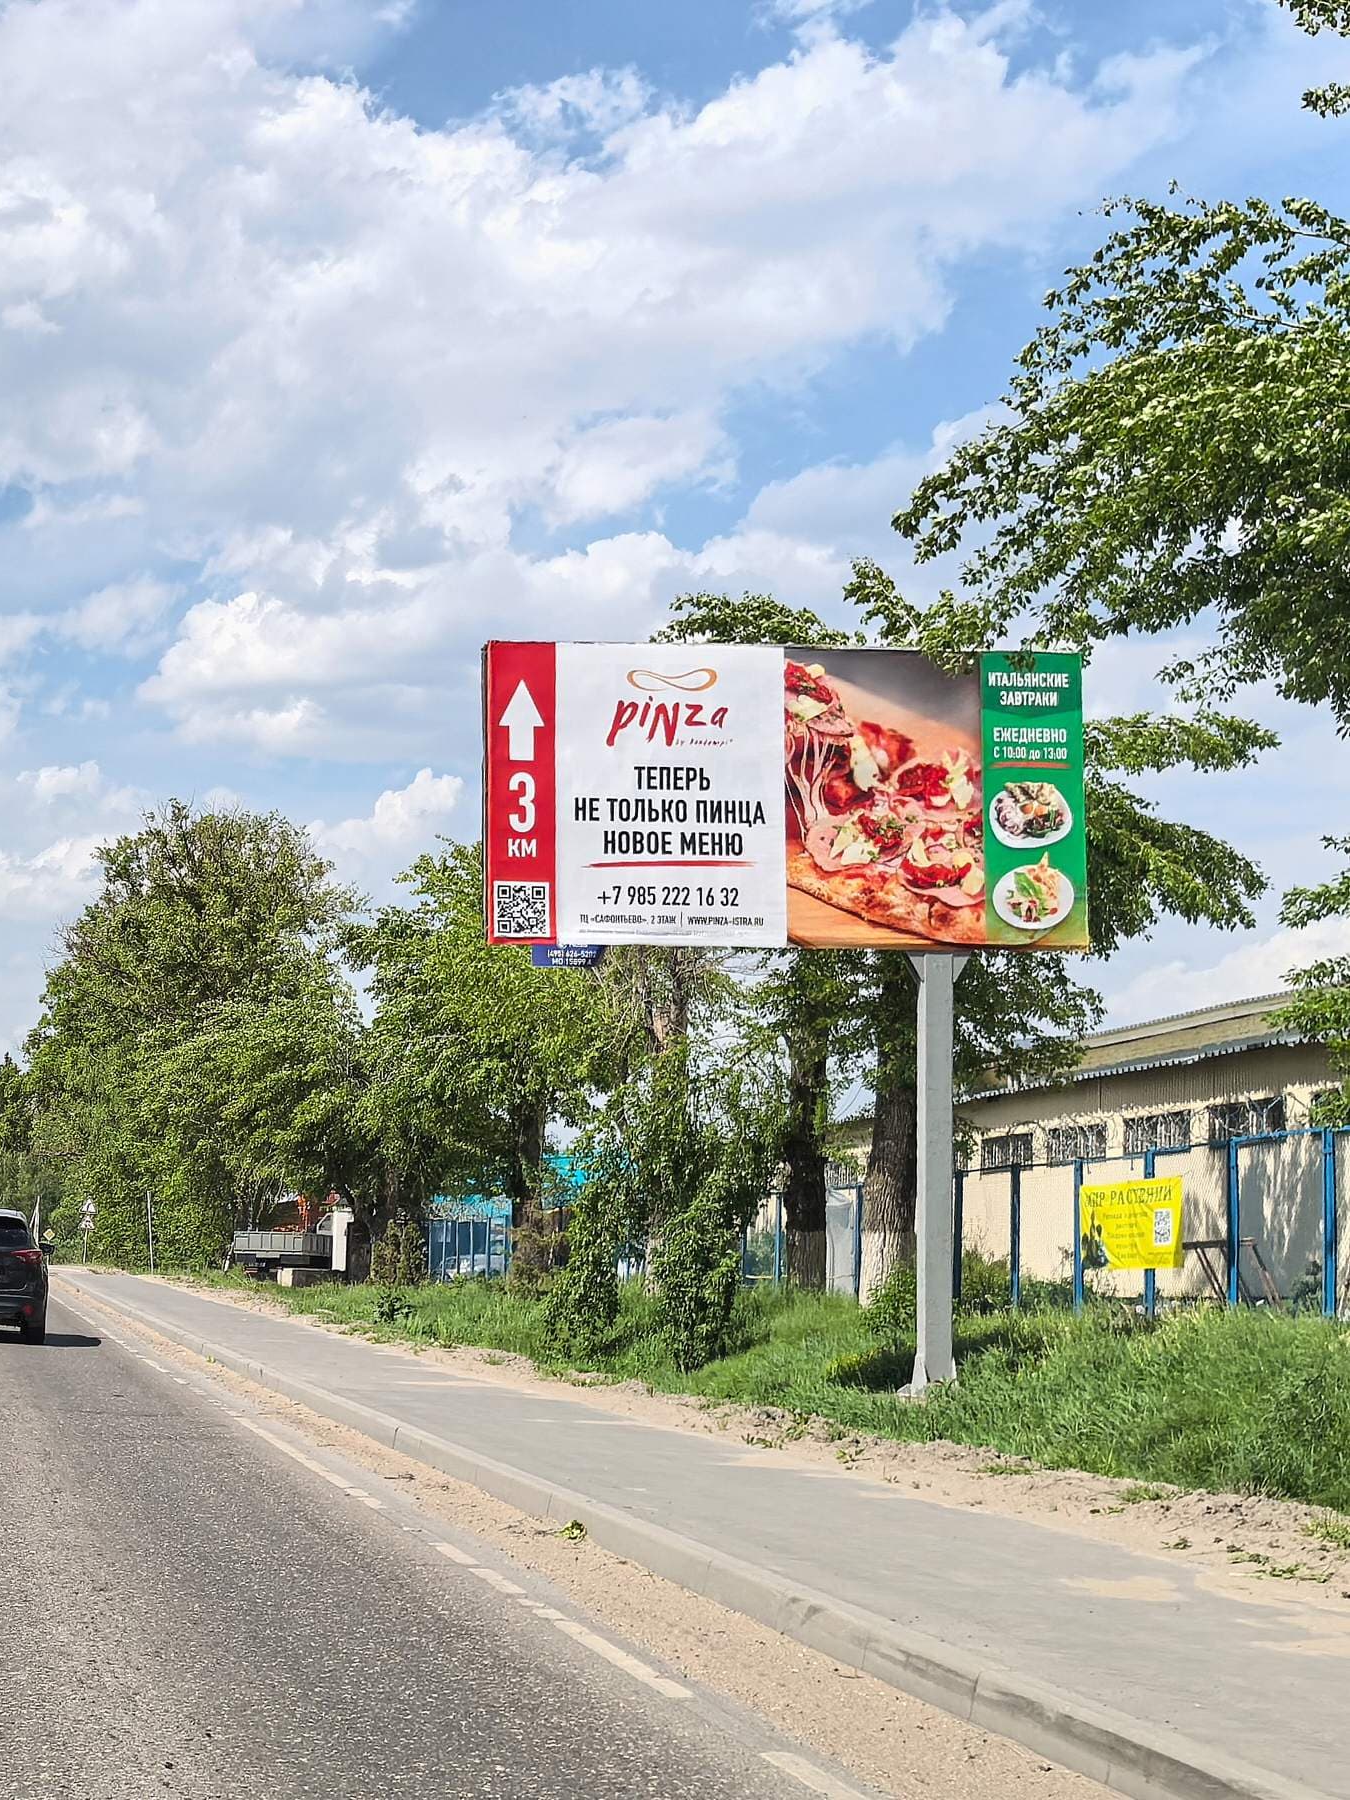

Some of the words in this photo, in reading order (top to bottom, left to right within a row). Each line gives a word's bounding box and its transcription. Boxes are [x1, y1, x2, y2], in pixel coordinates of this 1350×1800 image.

[988, 672, 1069, 688] ИТАЛЬЯНСКИЕ
[1000, 691, 1058, 706] ЗАВТРАКИ
[993, 728, 1067, 744] ЕЖЕДНЕВНО
[1002, 746, 1026, 759] 10:00
[1029, 750, 1040, 760] до
[1044, 748, 1067, 760] 13:00
[634, 766, 710, 791] ТЕПЕРЬ
[508, 772, 536, 833] 3
[575, 797, 600, 822] НЕ
[606, 798, 688, 823] ТОЛЬКО
[696, 800, 766, 827] ПИНЦА
[507, 838, 537, 858] КМ
[603, 831, 672, 856] НОВОЕ
[679, 832, 743, 856] МЕНЮ
[597, 886, 622, 906] +7
[627, 886, 656, 906] 985
[661, 886, 691, 906] 222
[696, 887, 715, 906] 16
[720, 887, 739, 907] 32
[651, 915, 656, 925] 2
[656, 914, 676, 925] ЭТАЖ
